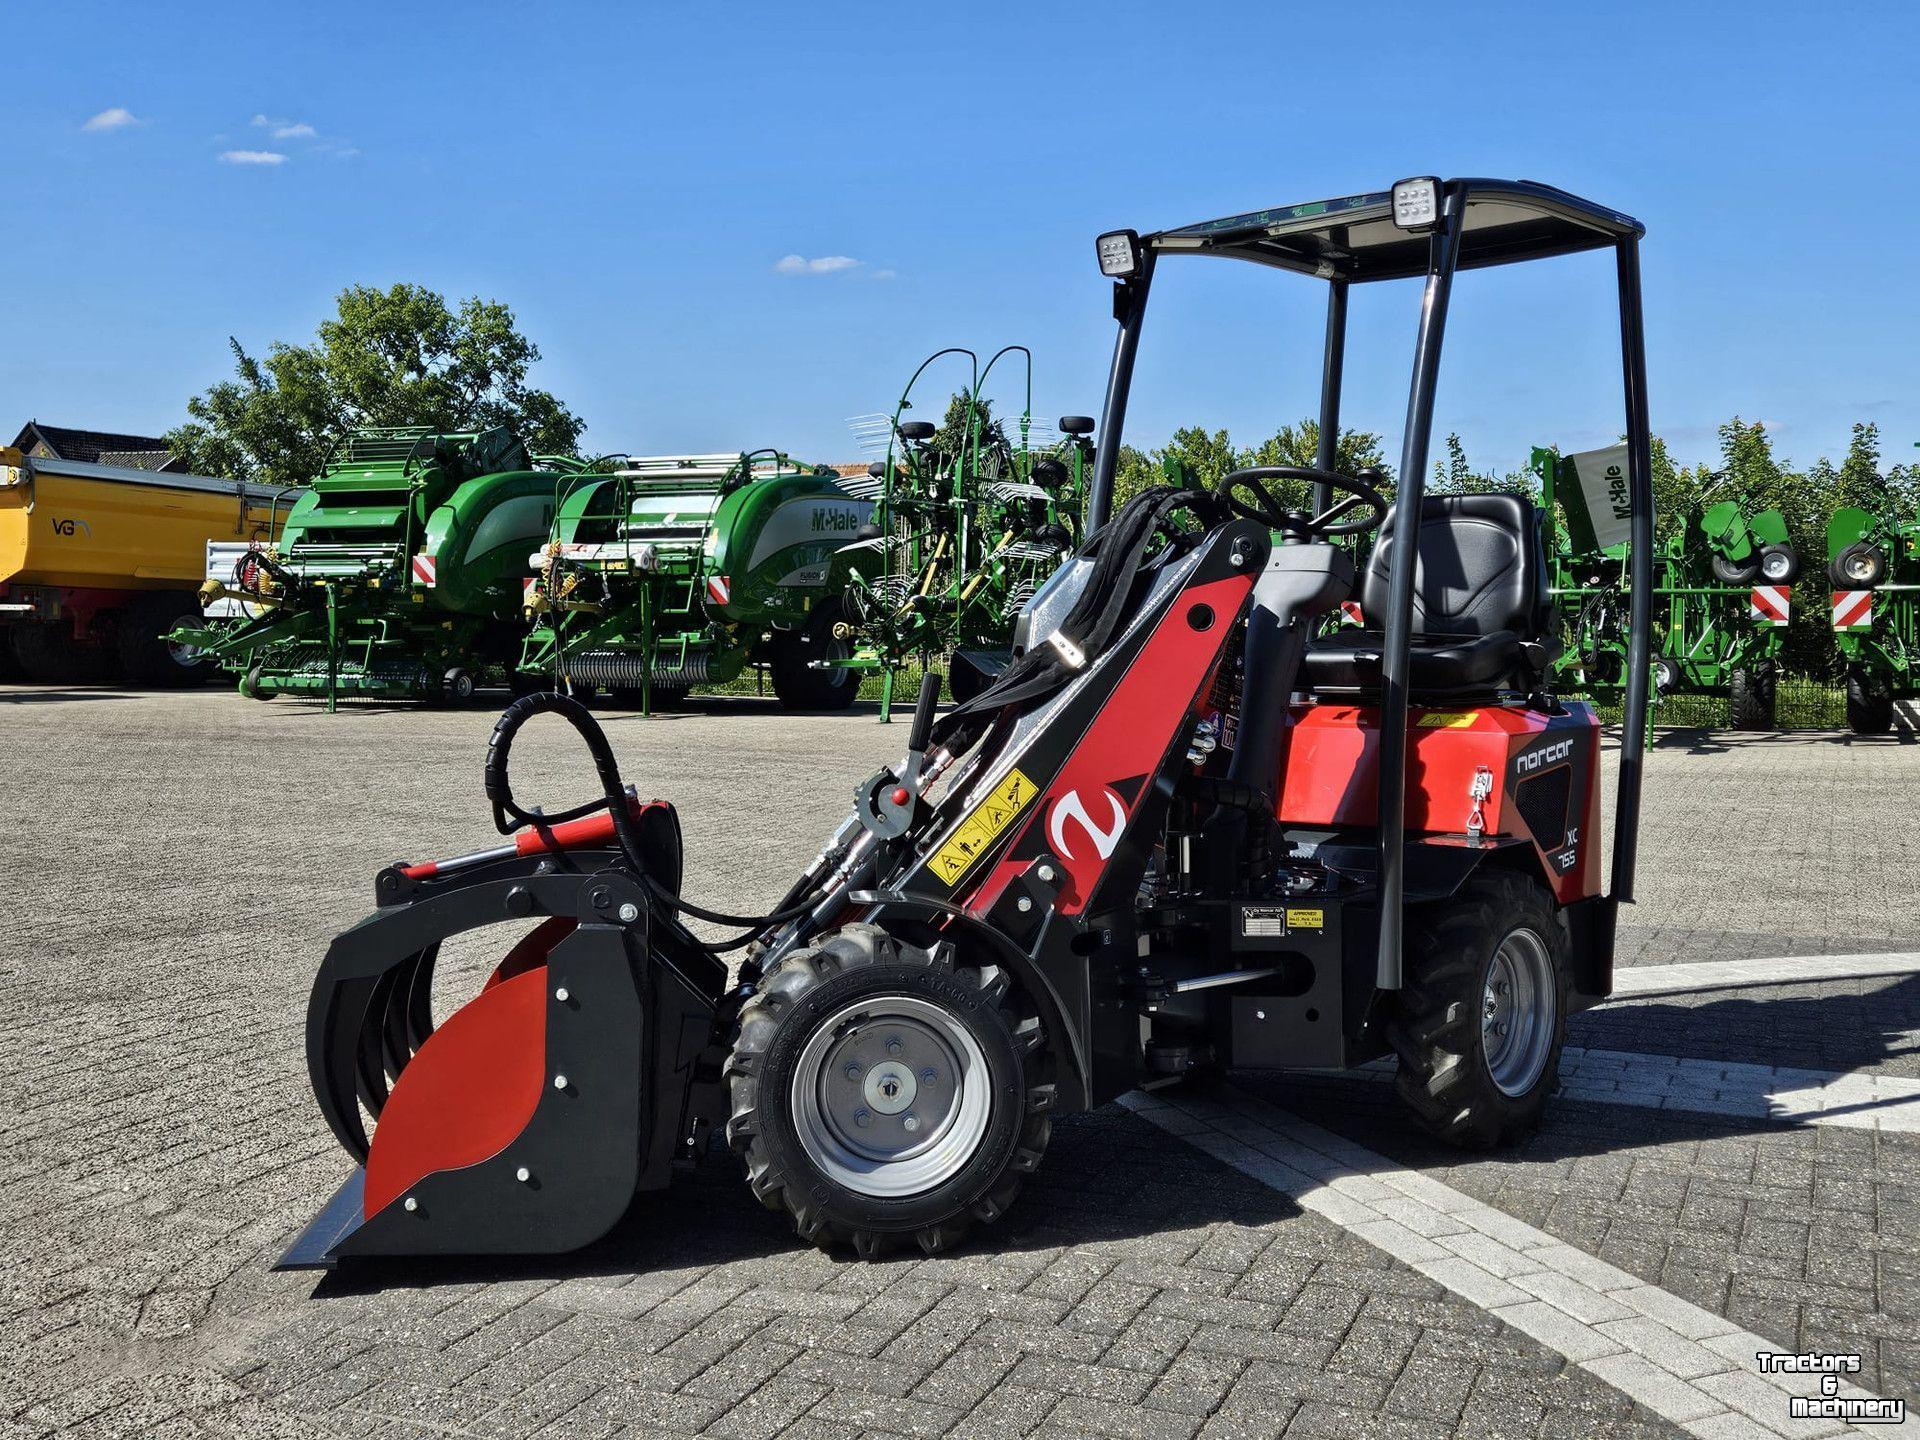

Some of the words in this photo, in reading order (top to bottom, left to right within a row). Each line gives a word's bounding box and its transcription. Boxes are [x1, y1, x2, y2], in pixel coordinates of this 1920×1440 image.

[1604, 465, 1632, 520] McHale
[52, 518, 75, 536] VG
[811, 507, 858, 531] McHale
[1517, 739, 1573, 774] norcar
[1567, 828, 1578, 847] XC
[1558, 850, 1576, 868] 755
